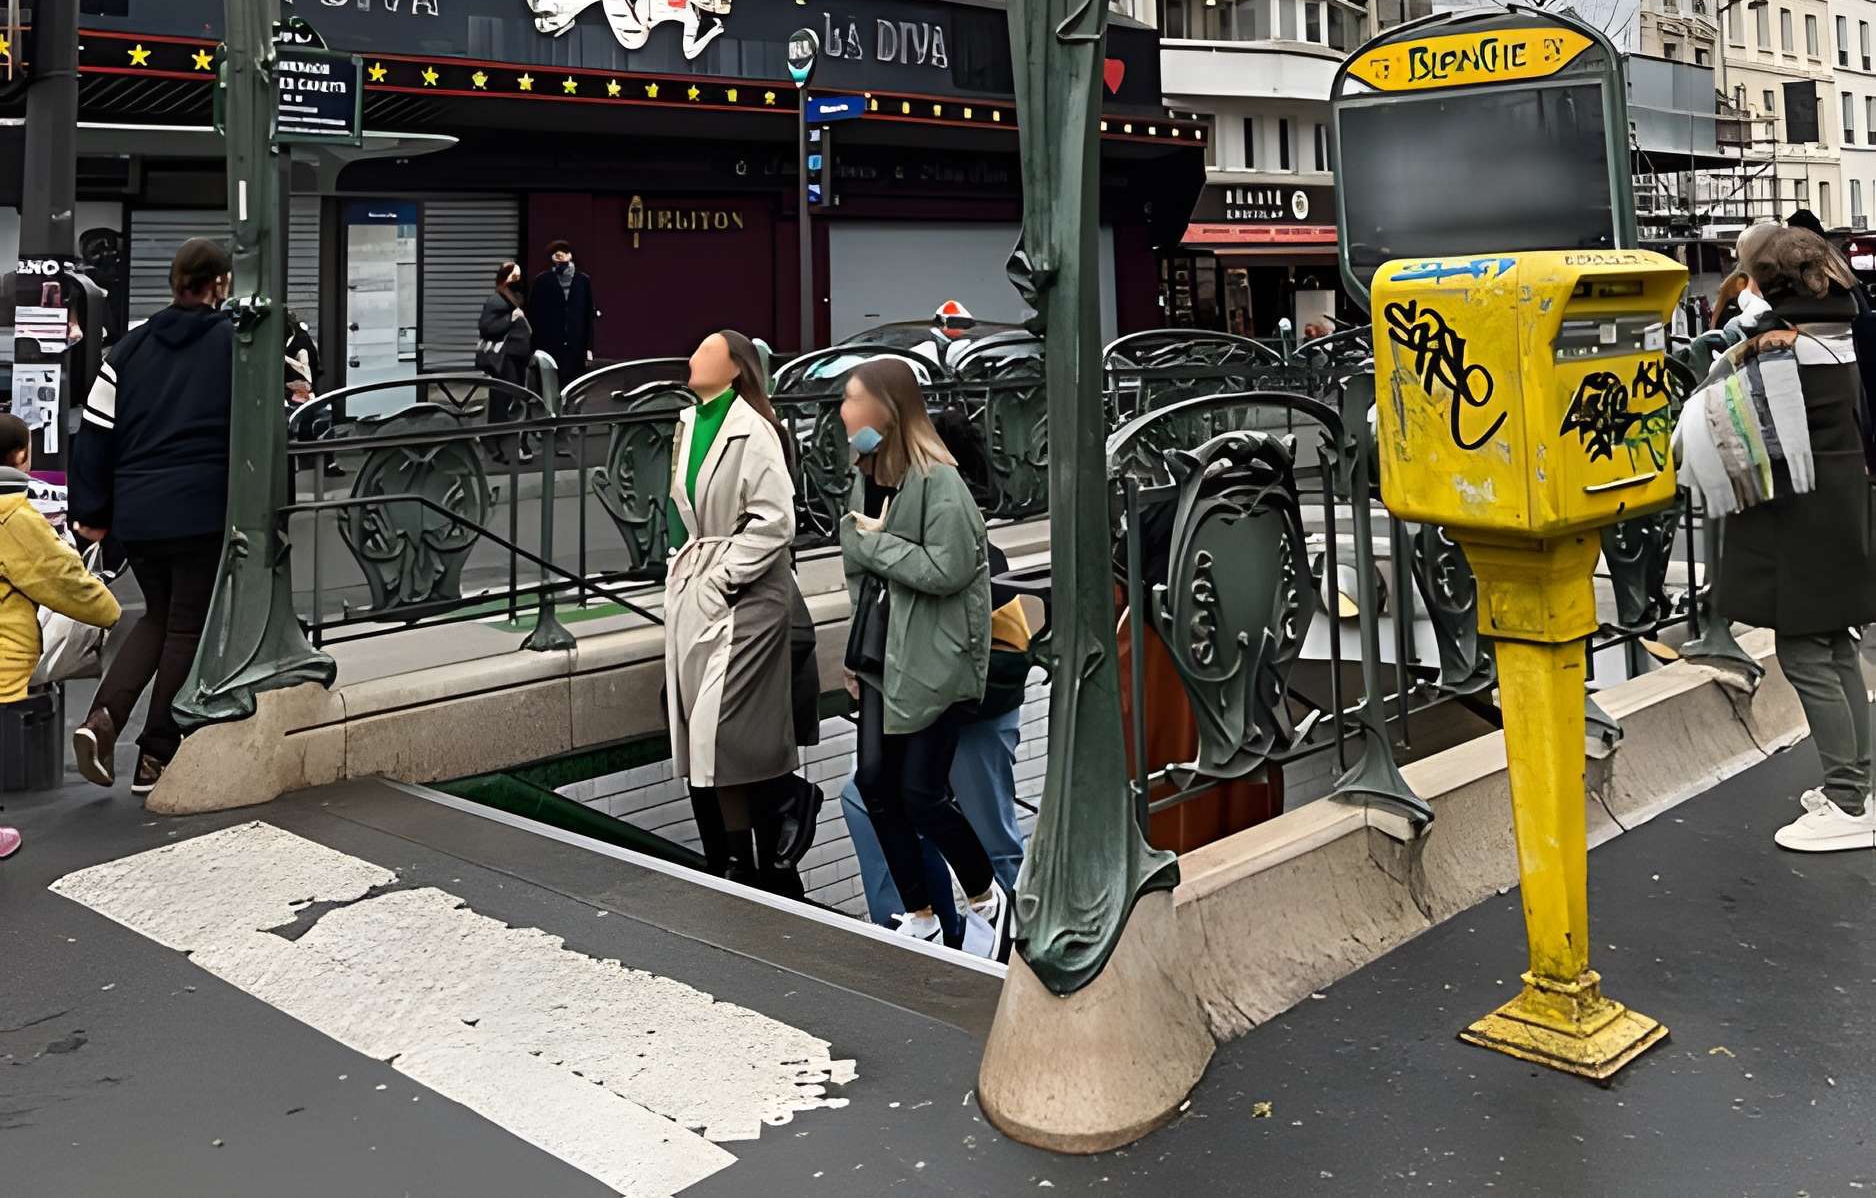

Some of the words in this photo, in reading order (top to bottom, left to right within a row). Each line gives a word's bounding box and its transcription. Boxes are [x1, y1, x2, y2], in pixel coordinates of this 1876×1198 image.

[824, 12, 863, 60] LA
[876, 18, 948, 69] DIVA
[1408, 38, 1527, 83] BLANCHE
